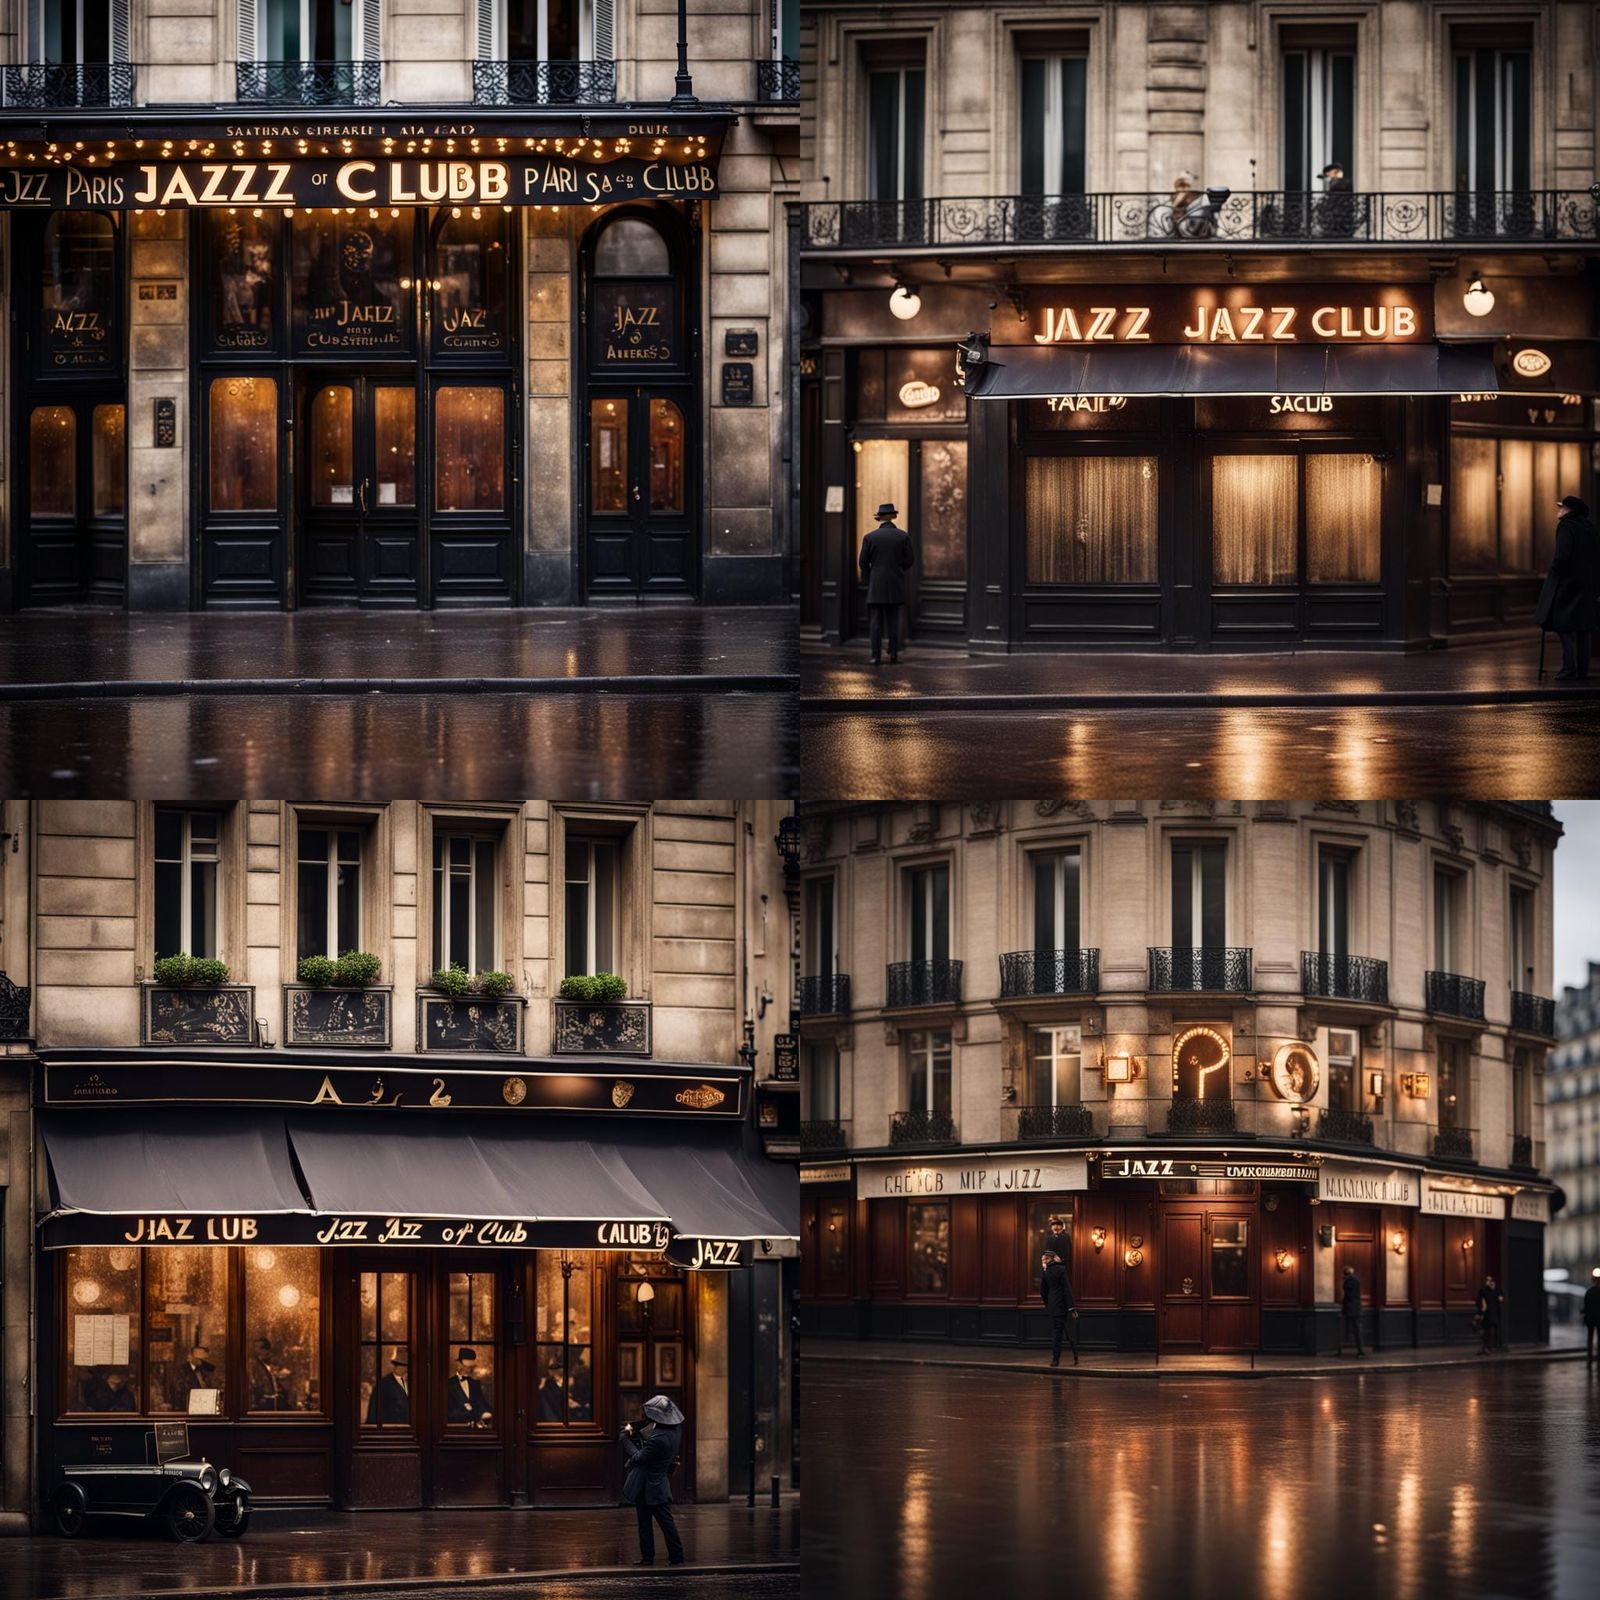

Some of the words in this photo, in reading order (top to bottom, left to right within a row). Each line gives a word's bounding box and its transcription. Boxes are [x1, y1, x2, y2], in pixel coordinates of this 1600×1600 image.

[66, 166, 124, 206] PARIS
[134, 164, 296, 206] JAZZZ
[611, 305, 660, 334] JAZZ
[1034, 307, 1151, 344] JAZZ
[1184, 306, 1297, 342] JAZZ
[1311, 306, 1417, 338] CLUB
[1118, 1159, 1174, 1177] JAZZ
[691, 1239, 741, 1269] JAZZ
